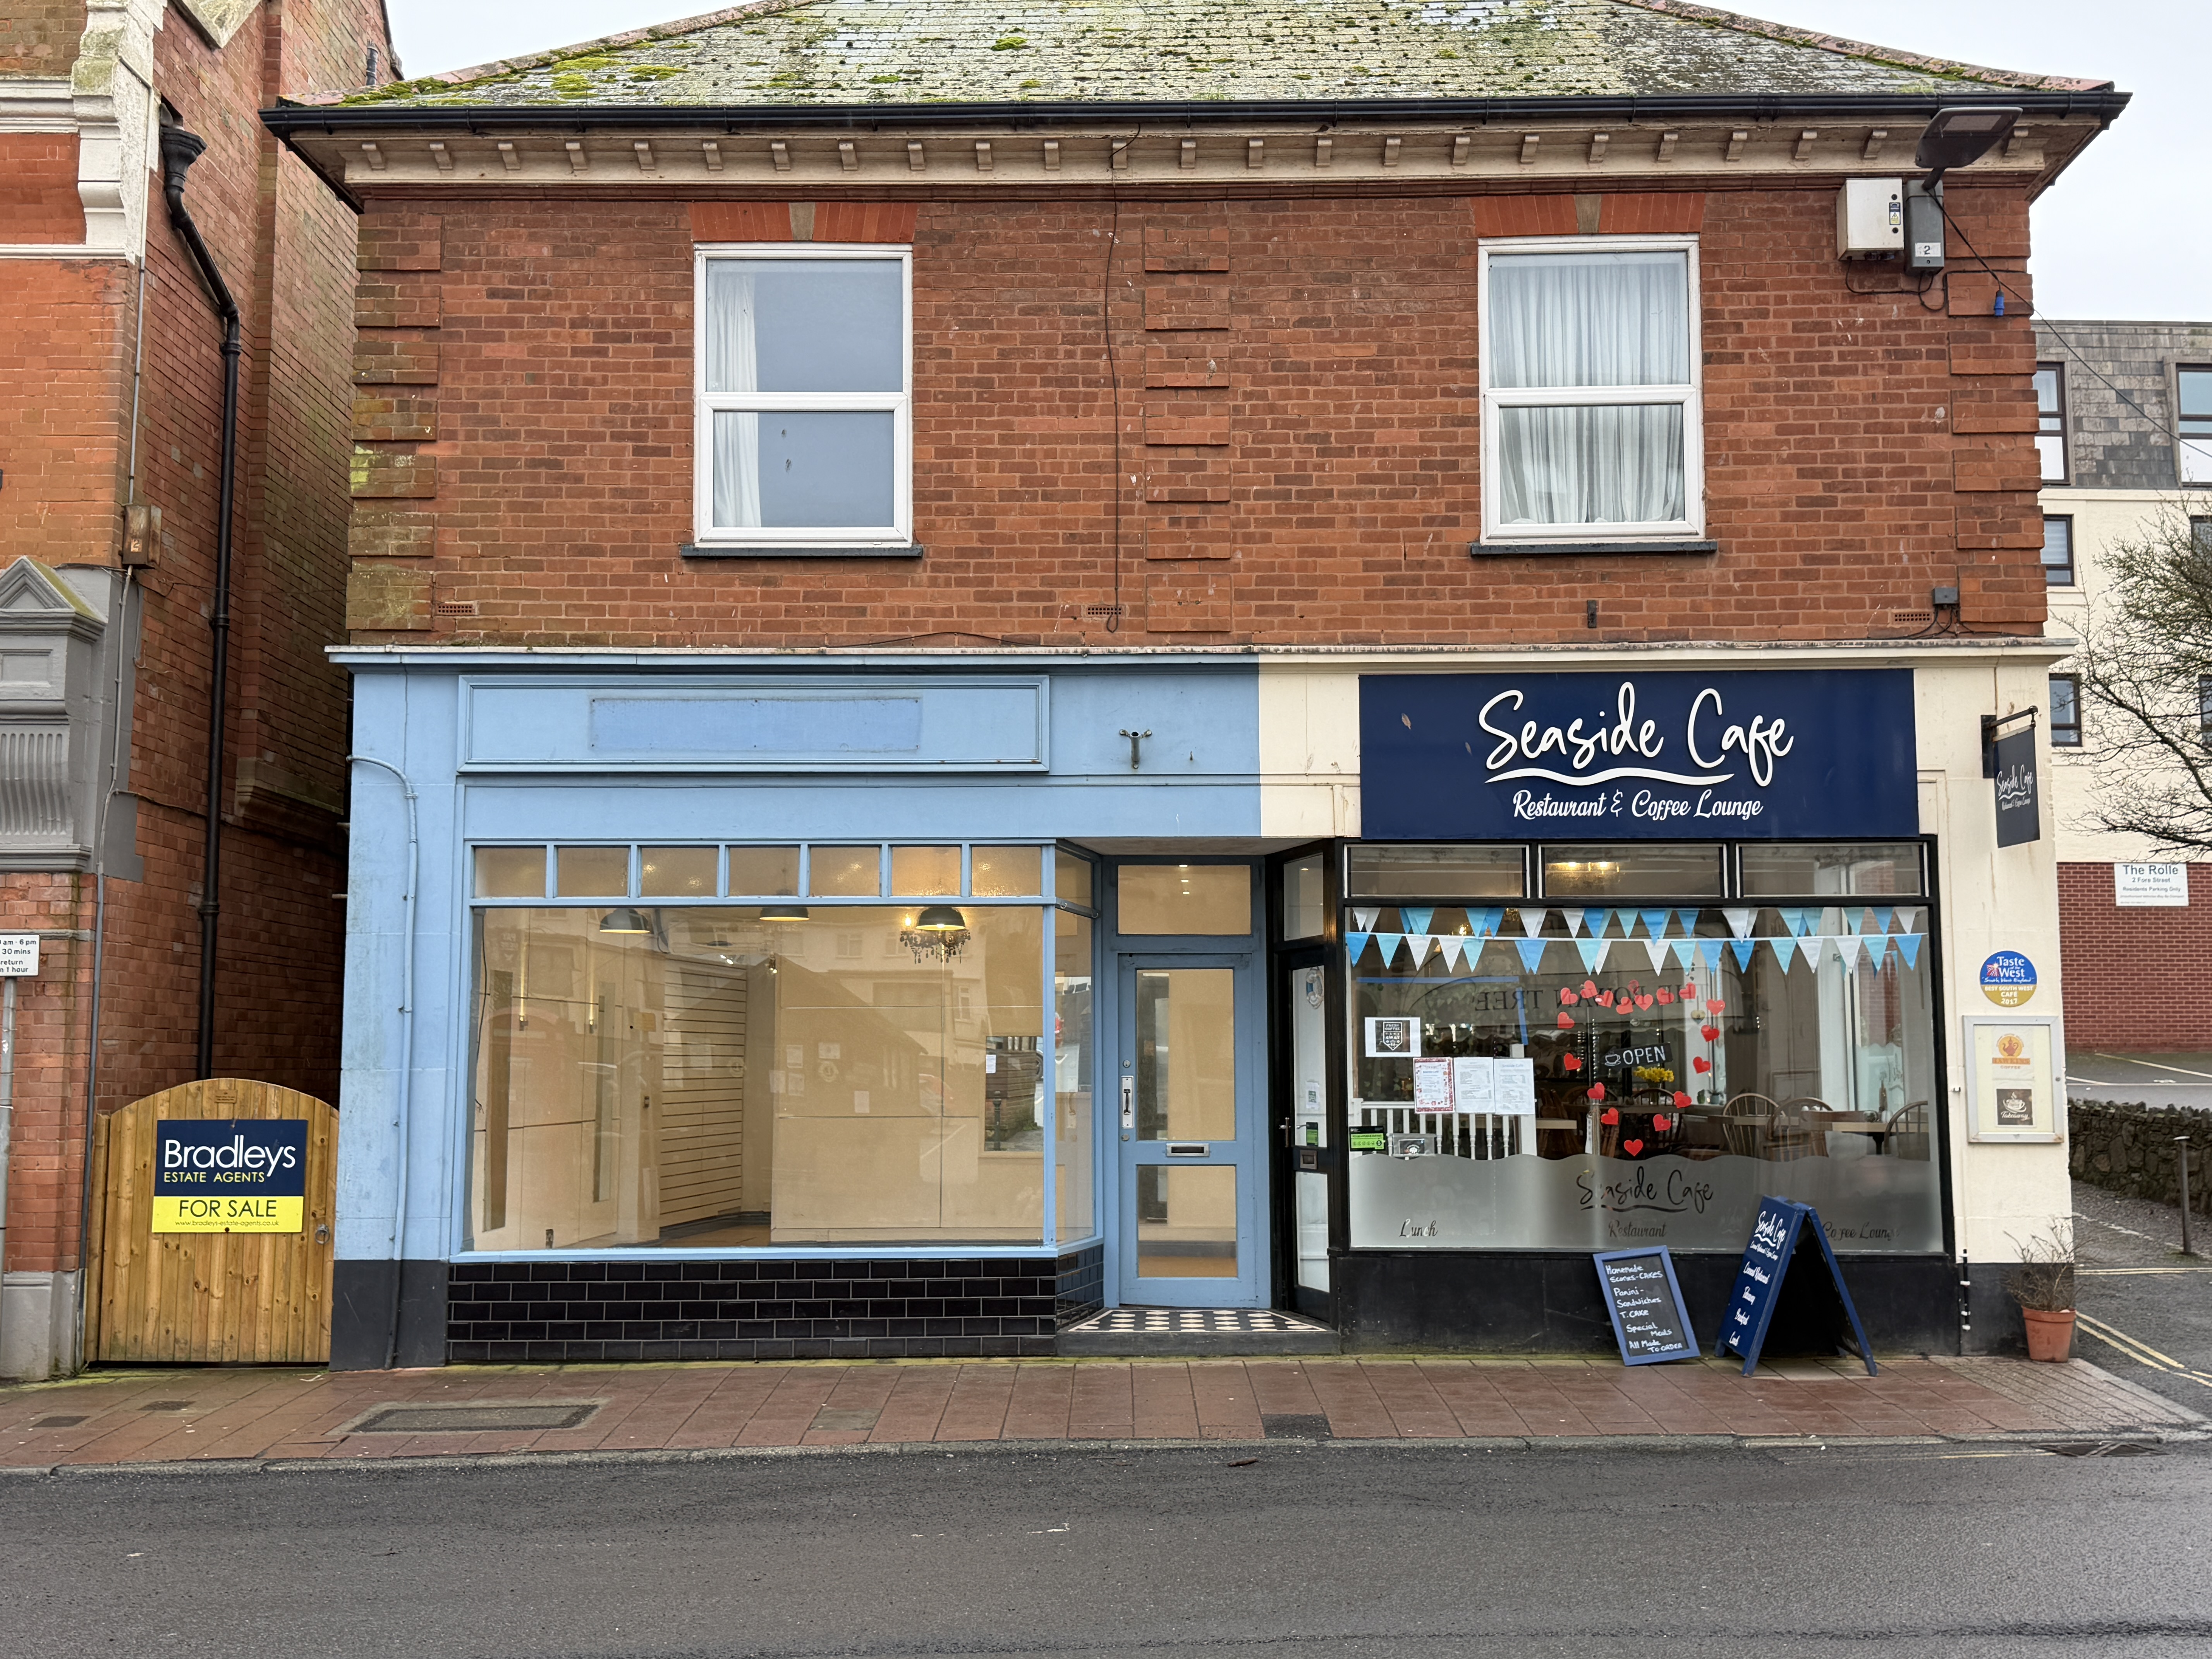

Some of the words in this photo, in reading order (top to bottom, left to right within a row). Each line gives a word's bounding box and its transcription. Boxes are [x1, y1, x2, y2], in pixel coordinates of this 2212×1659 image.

[1924, 245, 1930, 254] 2
[1479, 682, 1664, 769] Seaside
[1688, 688, 1794, 787] Cafe
[1997, 765, 2019, 797] Seaside
[1513, 790, 1607, 820] Restaurant
[1610, 789, 1623, 818] &
[1632, 790, 1690, 821] Coffee
[1694, 789, 1764, 820] Lounge
[2122, 865, 2144, 874] The
[2149, 865, 2178, 875] Rolle
[1997, 956, 2025, 966] Taste
[1998, 967, 2025, 977] West
[1623, 1046, 1666, 1065] OPEN
[165, 1135, 296, 1176] Bradleys
[164, 1172, 206, 1182] ESTATE
[213, 1172, 264, 1182] AGENTS
[1668, 1170, 1713, 1214] Cafe
[179, 1200, 220, 1217] FOR
[227, 1200, 276, 1217] SALE
[1399, 1218, 1438, 1238] Lunch
[1608, 1219, 1666, 1237] Restaurant
[1822, 1221, 1856, 1241] Cofee
[1606, 1264, 1644, 1274] Homemade
[1617, 1297, 1662, 1308] Sandwiches
[1626, 1322, 1658, 1333] Special
[1650, 1329, 1672, 1337] Meals
[1629, 1341, 1640, 1349] All
[1641, 1339, 1661, 1348] Made
